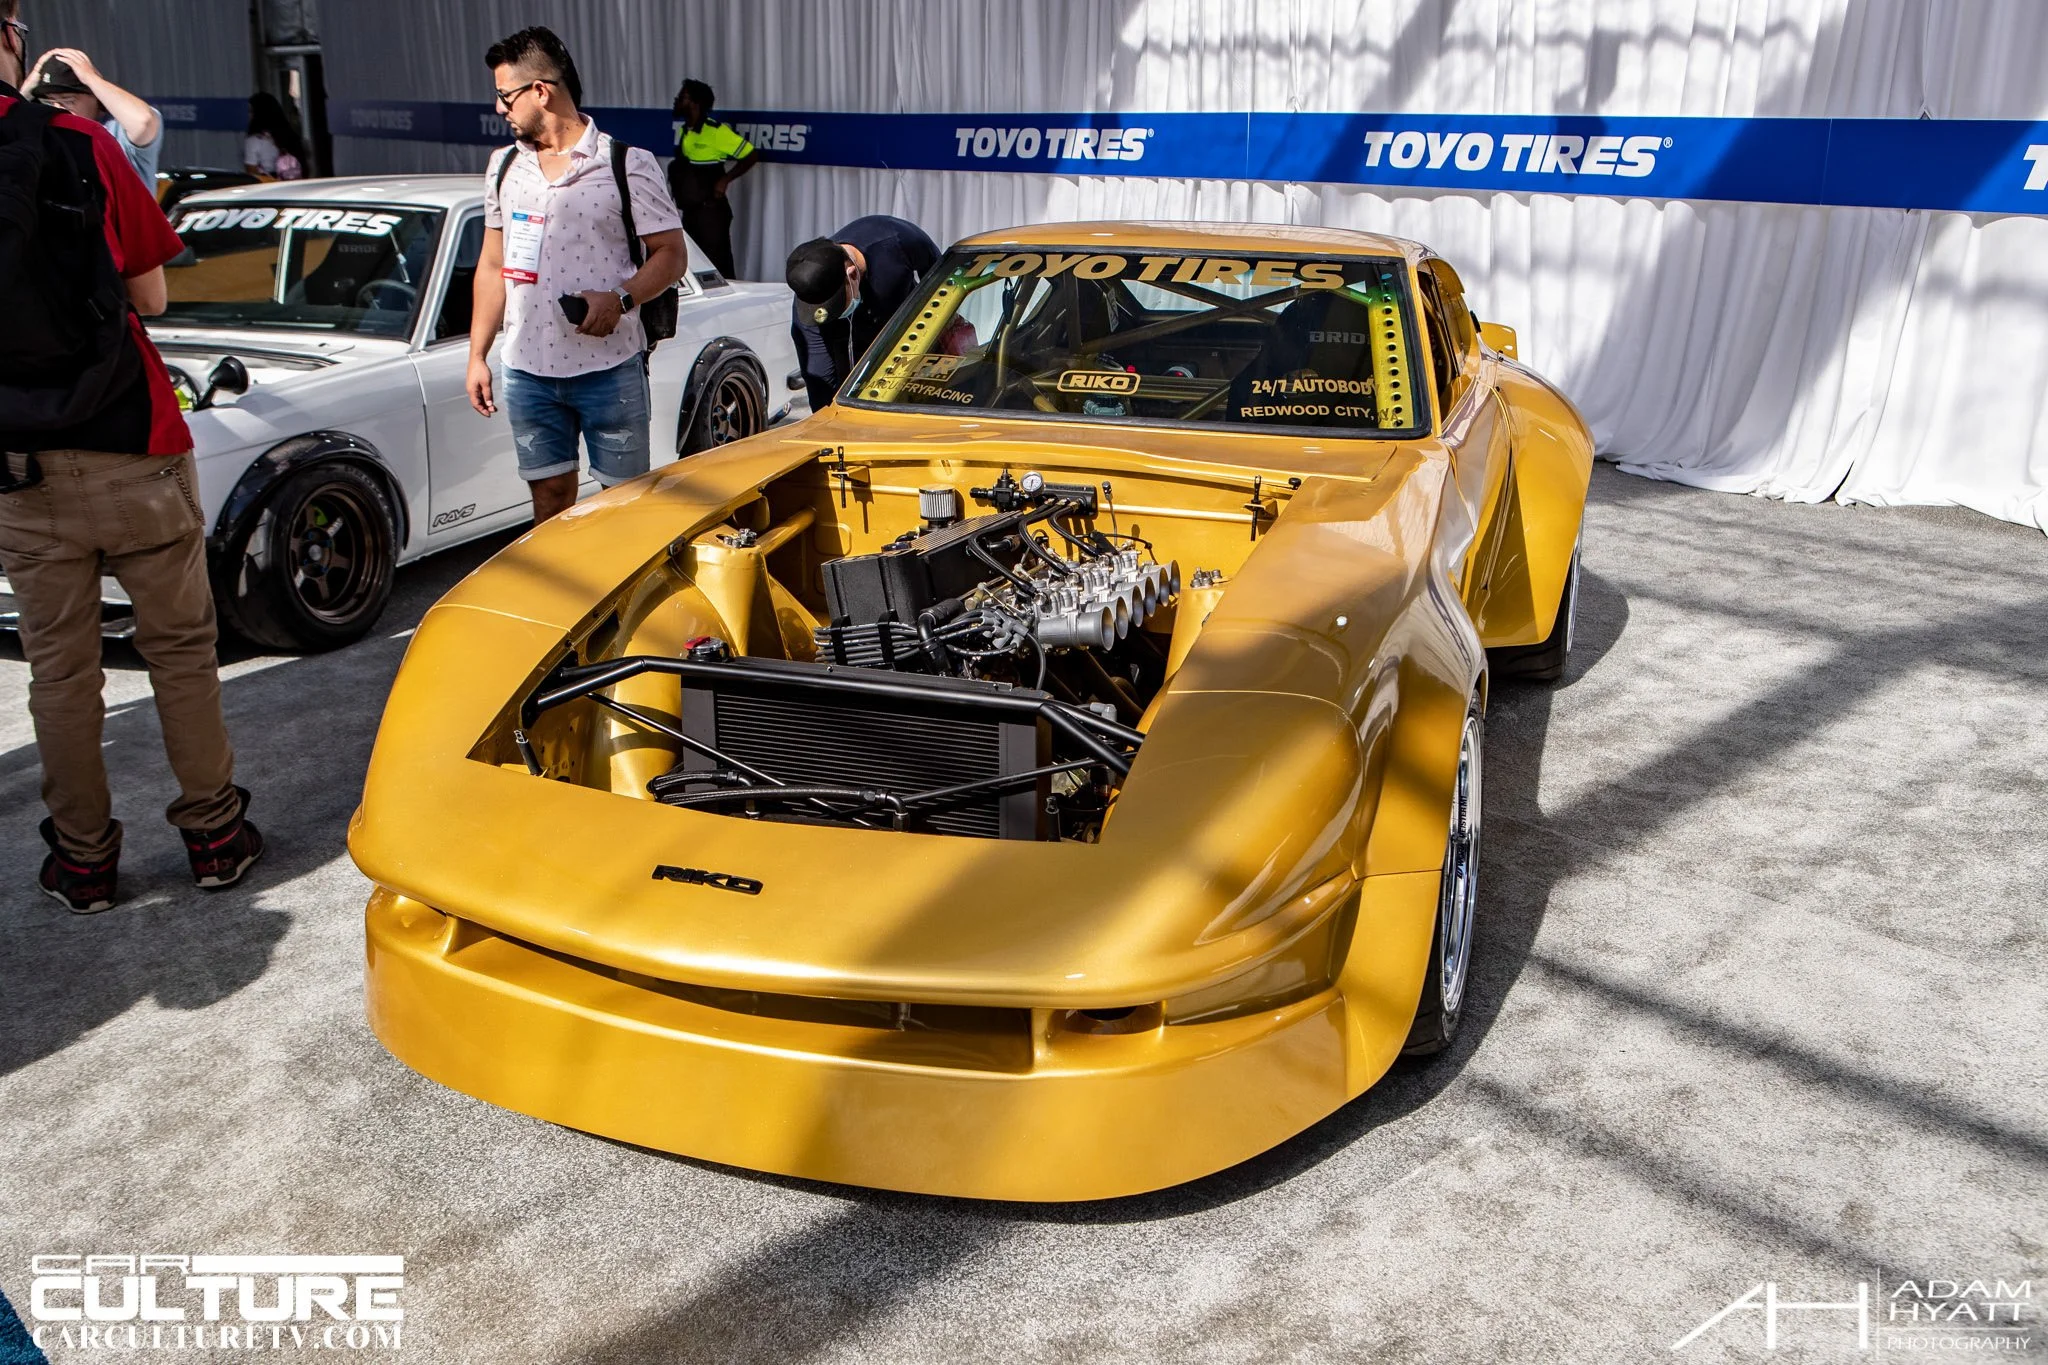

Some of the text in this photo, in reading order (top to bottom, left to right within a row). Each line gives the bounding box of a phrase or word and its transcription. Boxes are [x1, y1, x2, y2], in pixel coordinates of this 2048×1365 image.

[955, 127, 1041, 158] TOYO
[1364, 131, 1494, 171] TOYO
[175, 208, 402, 236] TOYO TIRES
[964, 254, 1345, 290] TOYO TIRES
[1309, 331, 1370, 344] BRID
[1068, 374, 1130, 390] RIKO
[1252, 379, 1288, 397] 24/7
[1241, 405, 1330, 417] REDWOOD
[1334, 406, 1375, 421] CITY,
[432, 503, 476, 528] RAYS
[652, 865, 764, 895] RIKO
